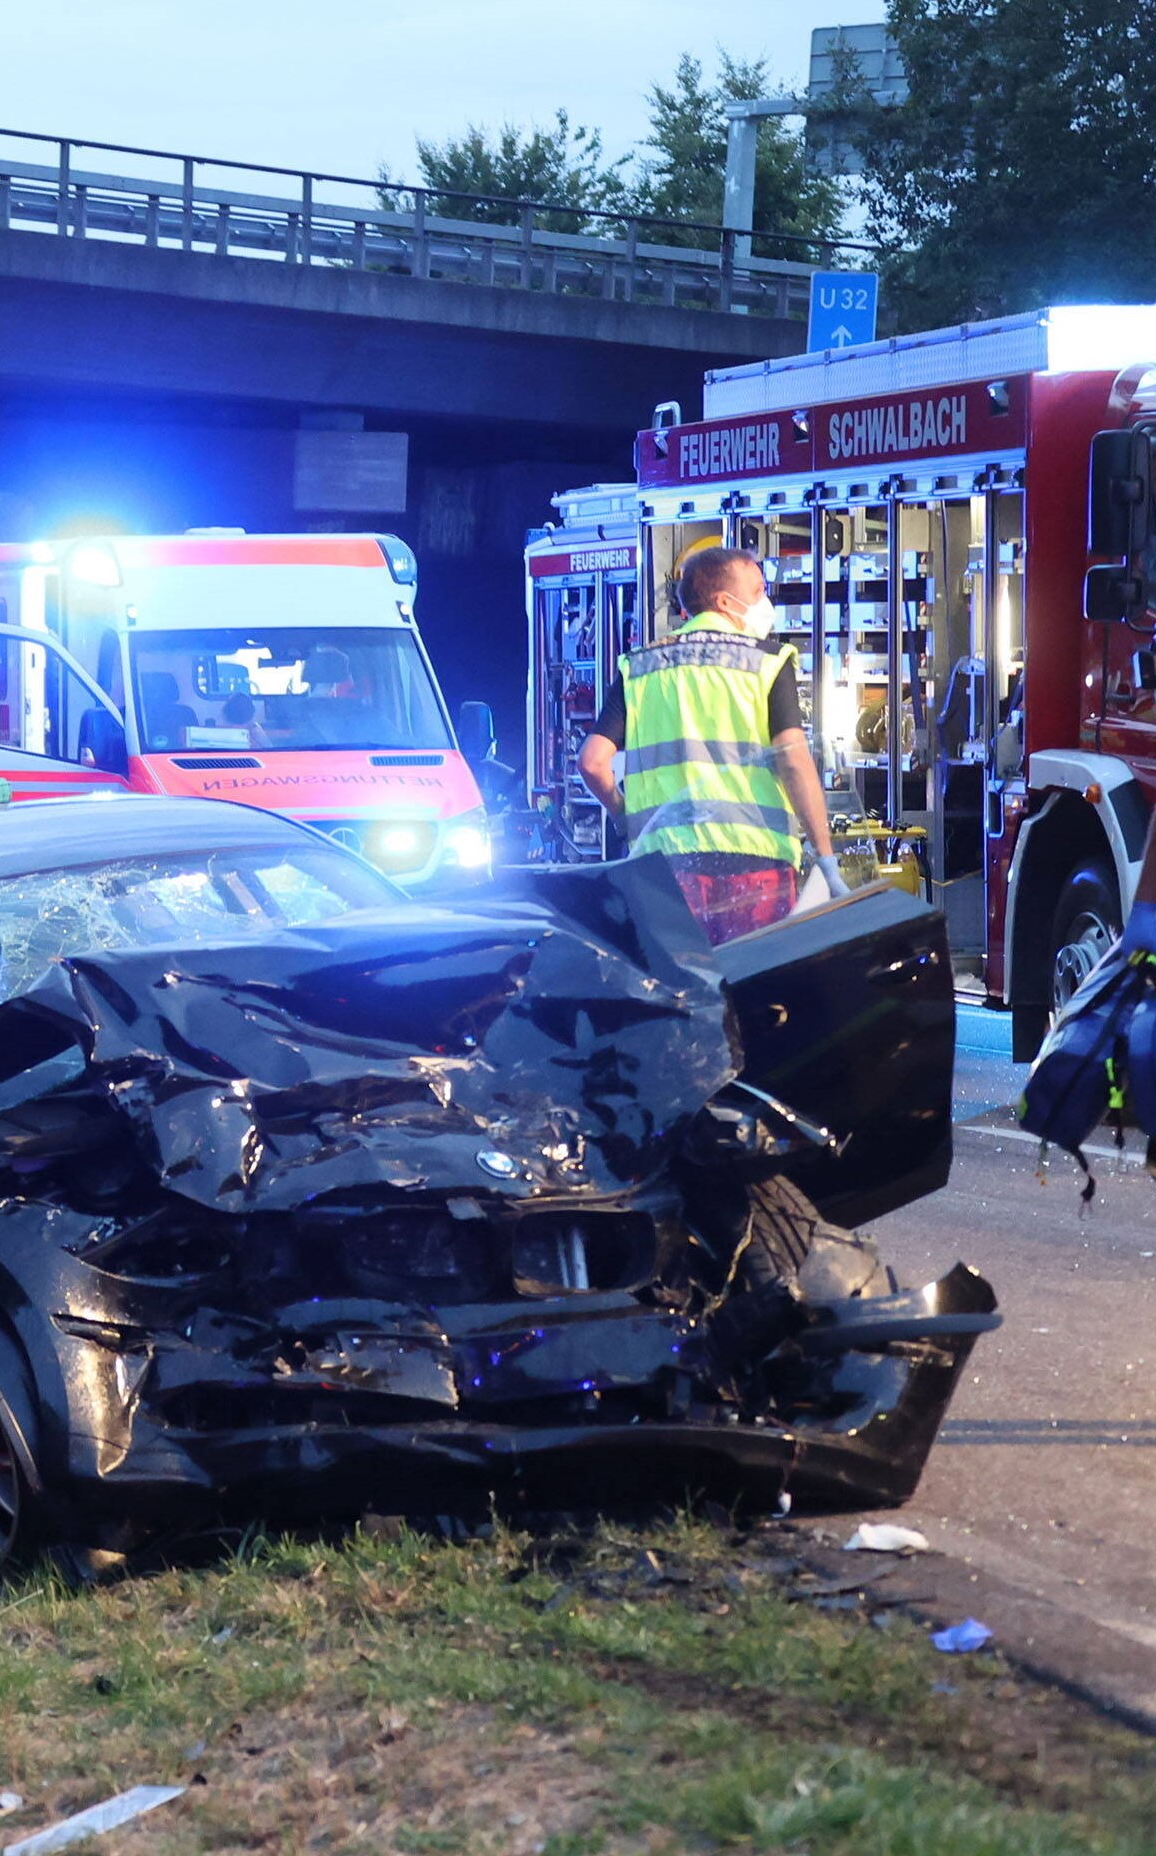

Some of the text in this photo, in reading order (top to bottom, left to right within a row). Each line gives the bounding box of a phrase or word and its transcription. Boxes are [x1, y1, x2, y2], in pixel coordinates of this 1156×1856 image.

[820, 287, 868, 310] U 32
[679, 395, 966, 478] FEUERWEHR SCHWALBACH
[570, 548, 631, 572] FEUERWEHR
